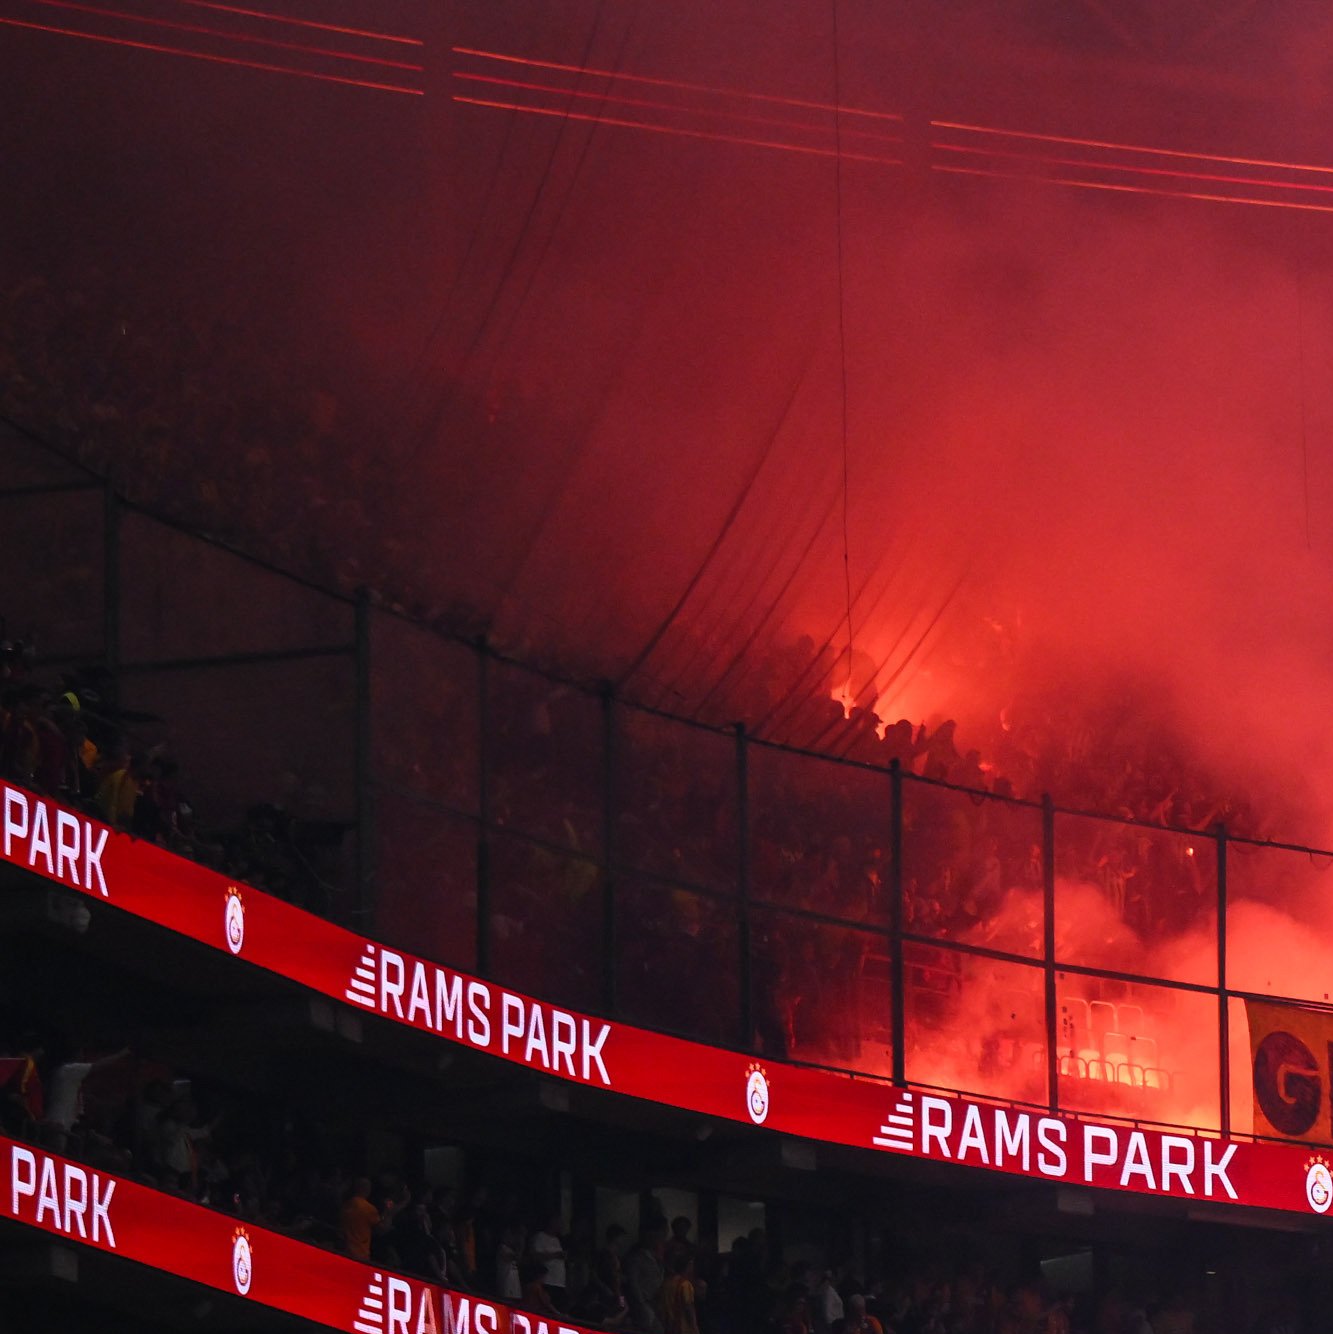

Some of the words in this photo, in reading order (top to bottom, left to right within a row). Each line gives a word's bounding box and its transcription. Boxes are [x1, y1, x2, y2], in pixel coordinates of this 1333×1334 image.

[5, 787, 108, 896] PARK
[381, 950, 490, 1046] RAMS
[503, 993, 610, 1084] PARK
[13, 1146, 115, 1247] PARK
[922, 1096, 1066, 1176] RAMS
[1084, 1127, 1238, 1199] PARK
